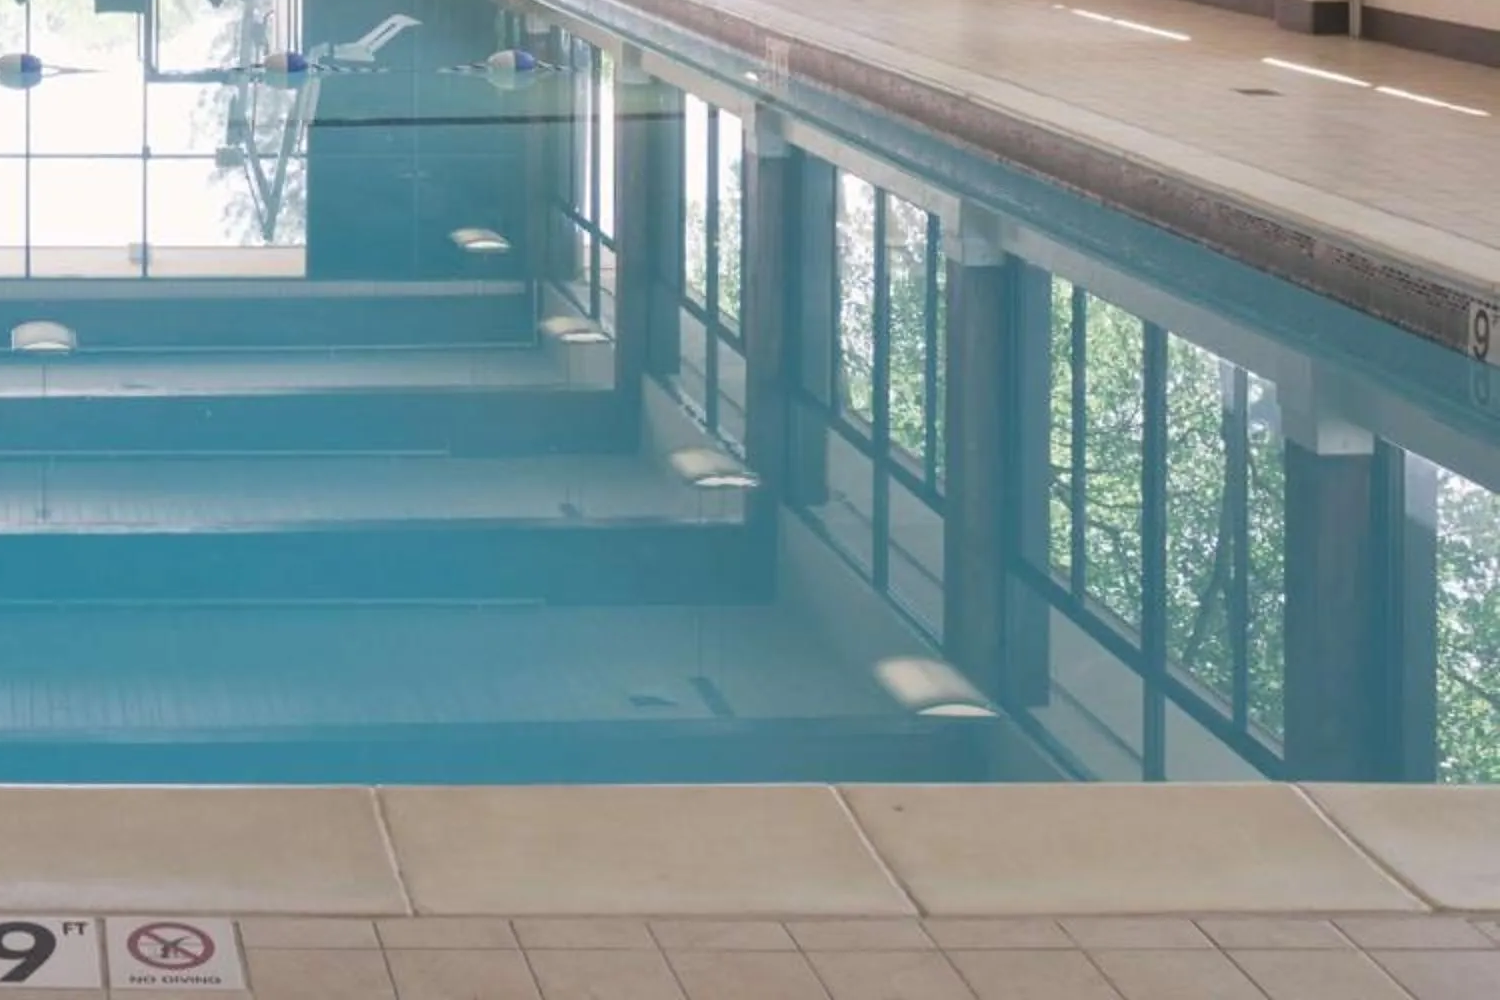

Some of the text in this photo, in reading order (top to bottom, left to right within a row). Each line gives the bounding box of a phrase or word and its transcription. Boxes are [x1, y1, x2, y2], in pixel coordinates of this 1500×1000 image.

[1473, 308, 1489, 361] 9
[62, 921, 88, 936] FT
[129, 974, 222, 985] NO DIVING
